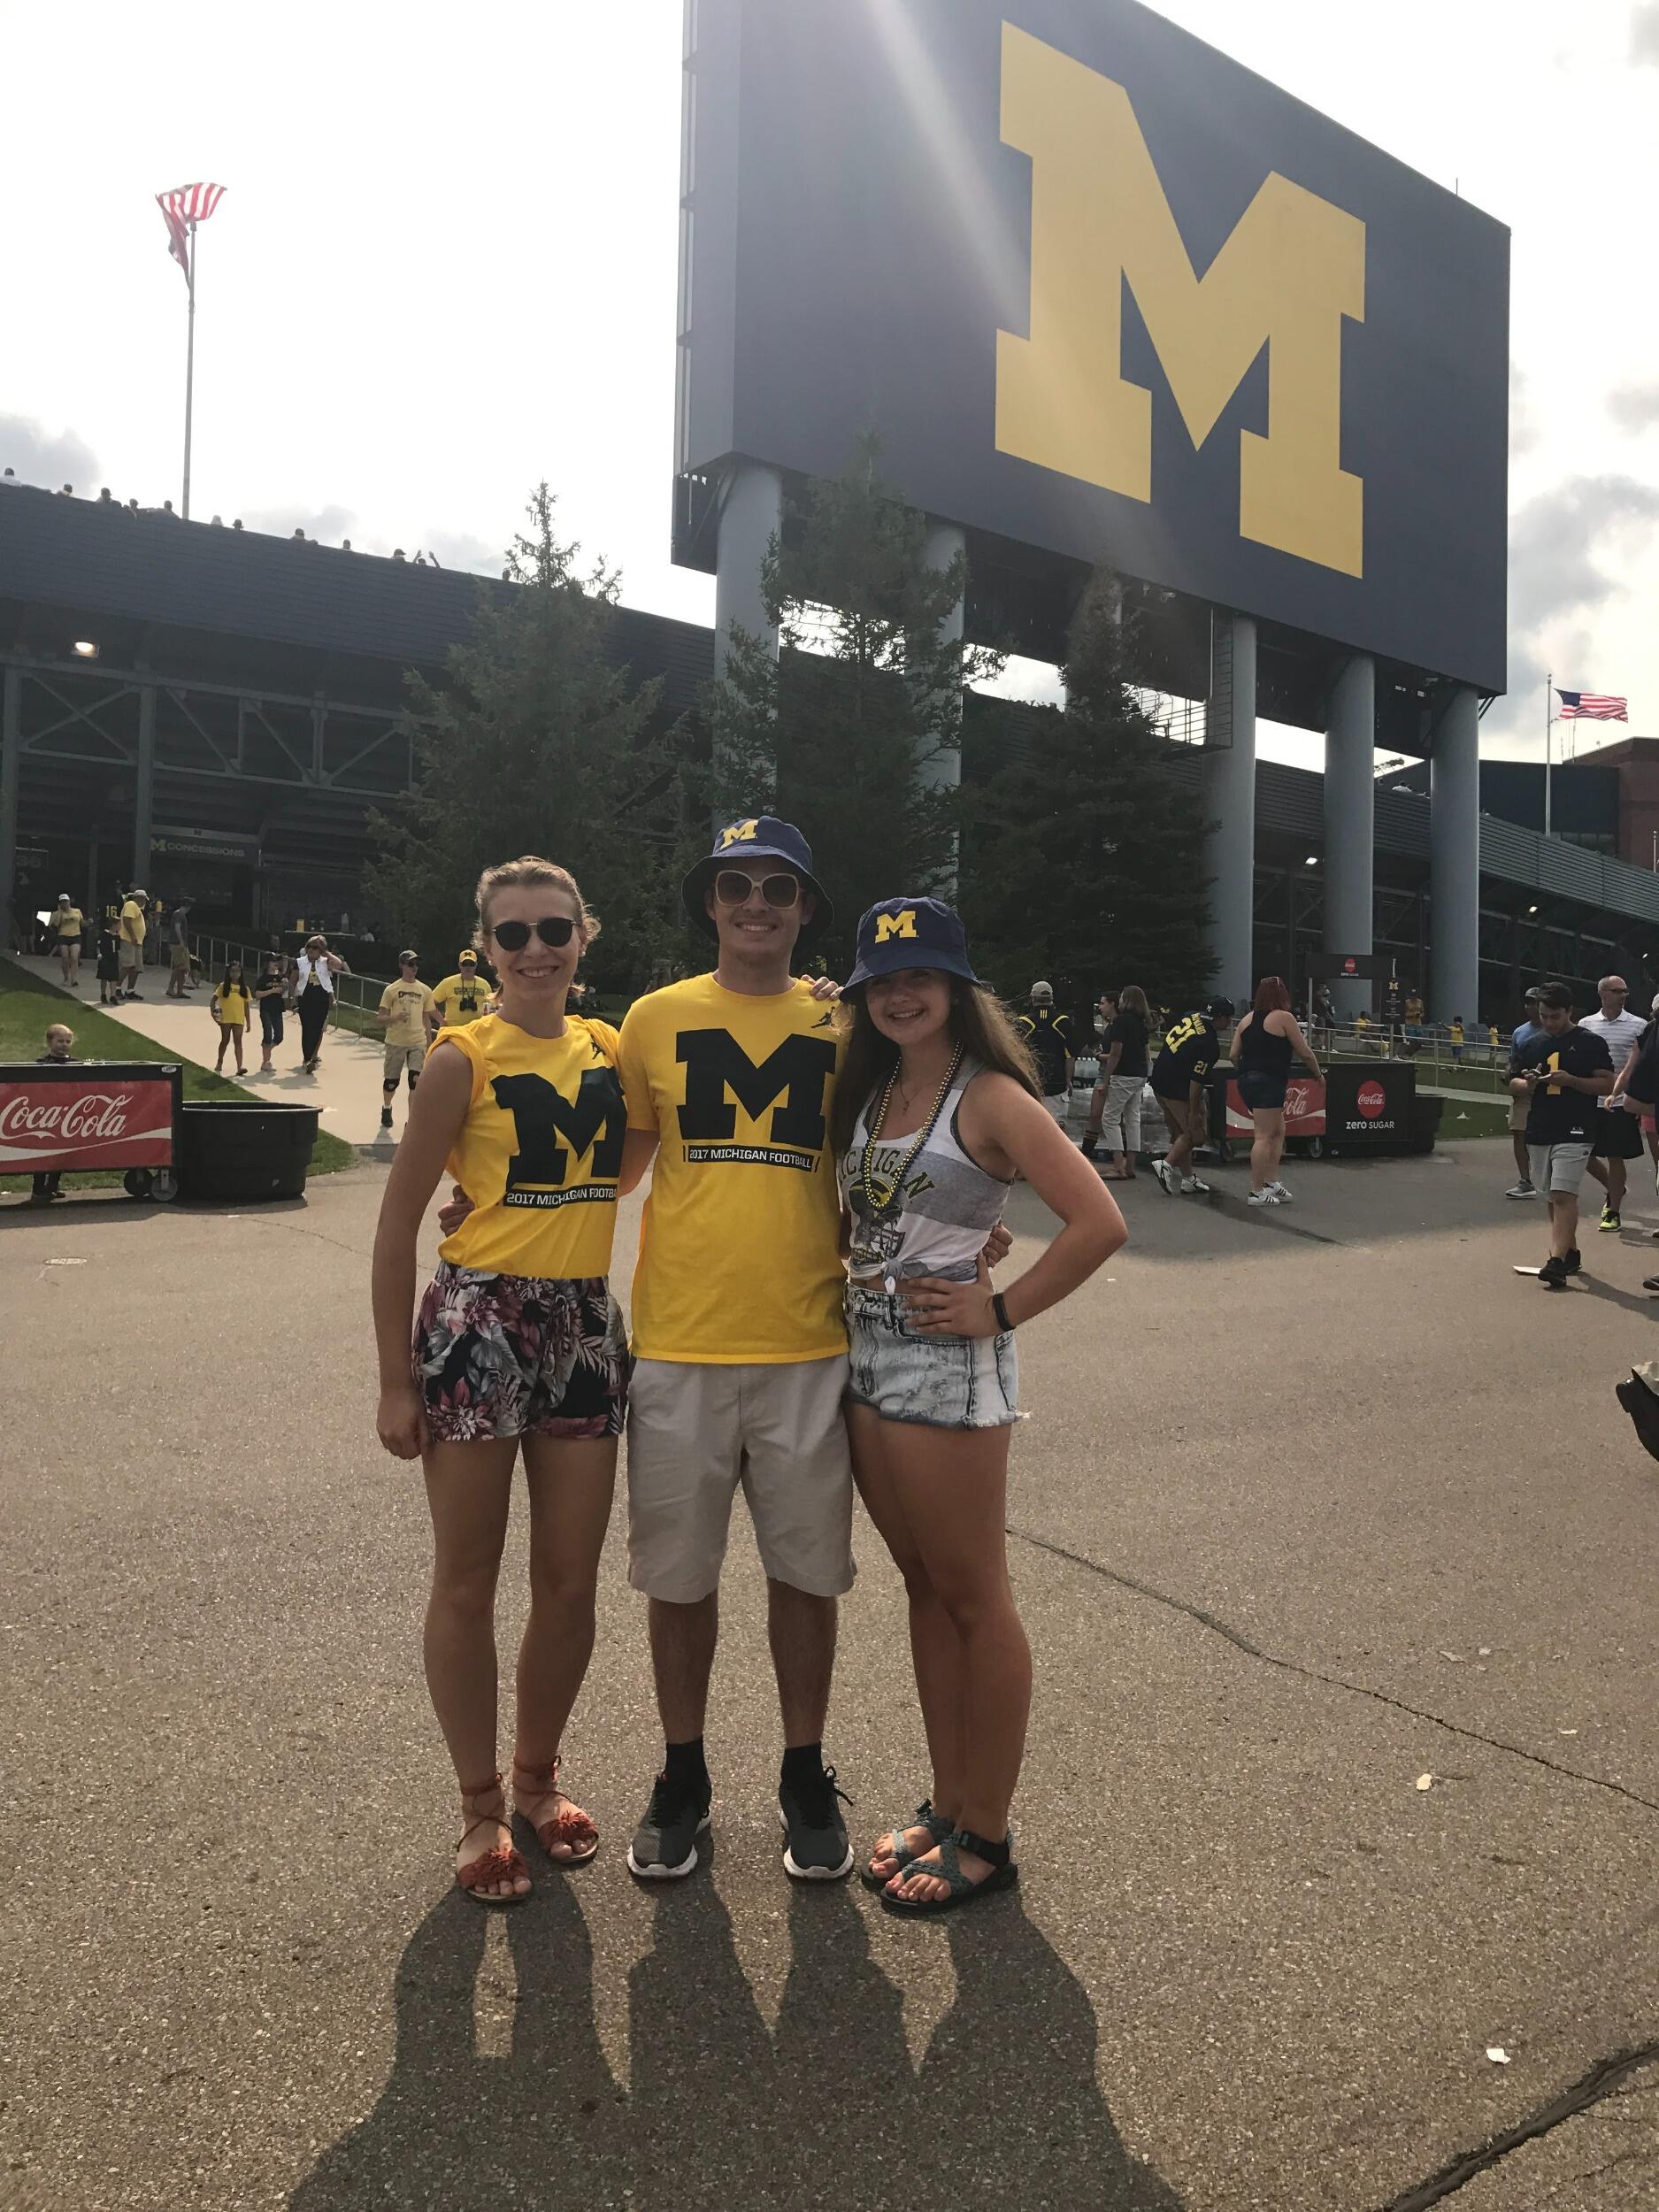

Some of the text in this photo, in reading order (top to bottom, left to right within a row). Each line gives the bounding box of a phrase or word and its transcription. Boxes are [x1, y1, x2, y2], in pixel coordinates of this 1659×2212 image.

[995, 19, 1366, 579] M
[167, 841, 245, 857] CONCESSIONS
[719, 818, 758, 849] M
[875, 910, 918, 943] M
[1165, 1017, 1197, 1055] 21
[1194, 1060, 1208, 1076] 21
[1547, 1051, 1561, 1095] 1
[675, 1028, 837, 1150] M
[0, 1094, 134, 1140] Coca-Cola
[489, 1066, 627, 1189] M
[689, 1148, 811, 1169] 2017 MICHIGAN FOOTBALL
[506, 1193, 534, 1204] 2017
[536, 1187, 588, 1205] MICHIGAN
